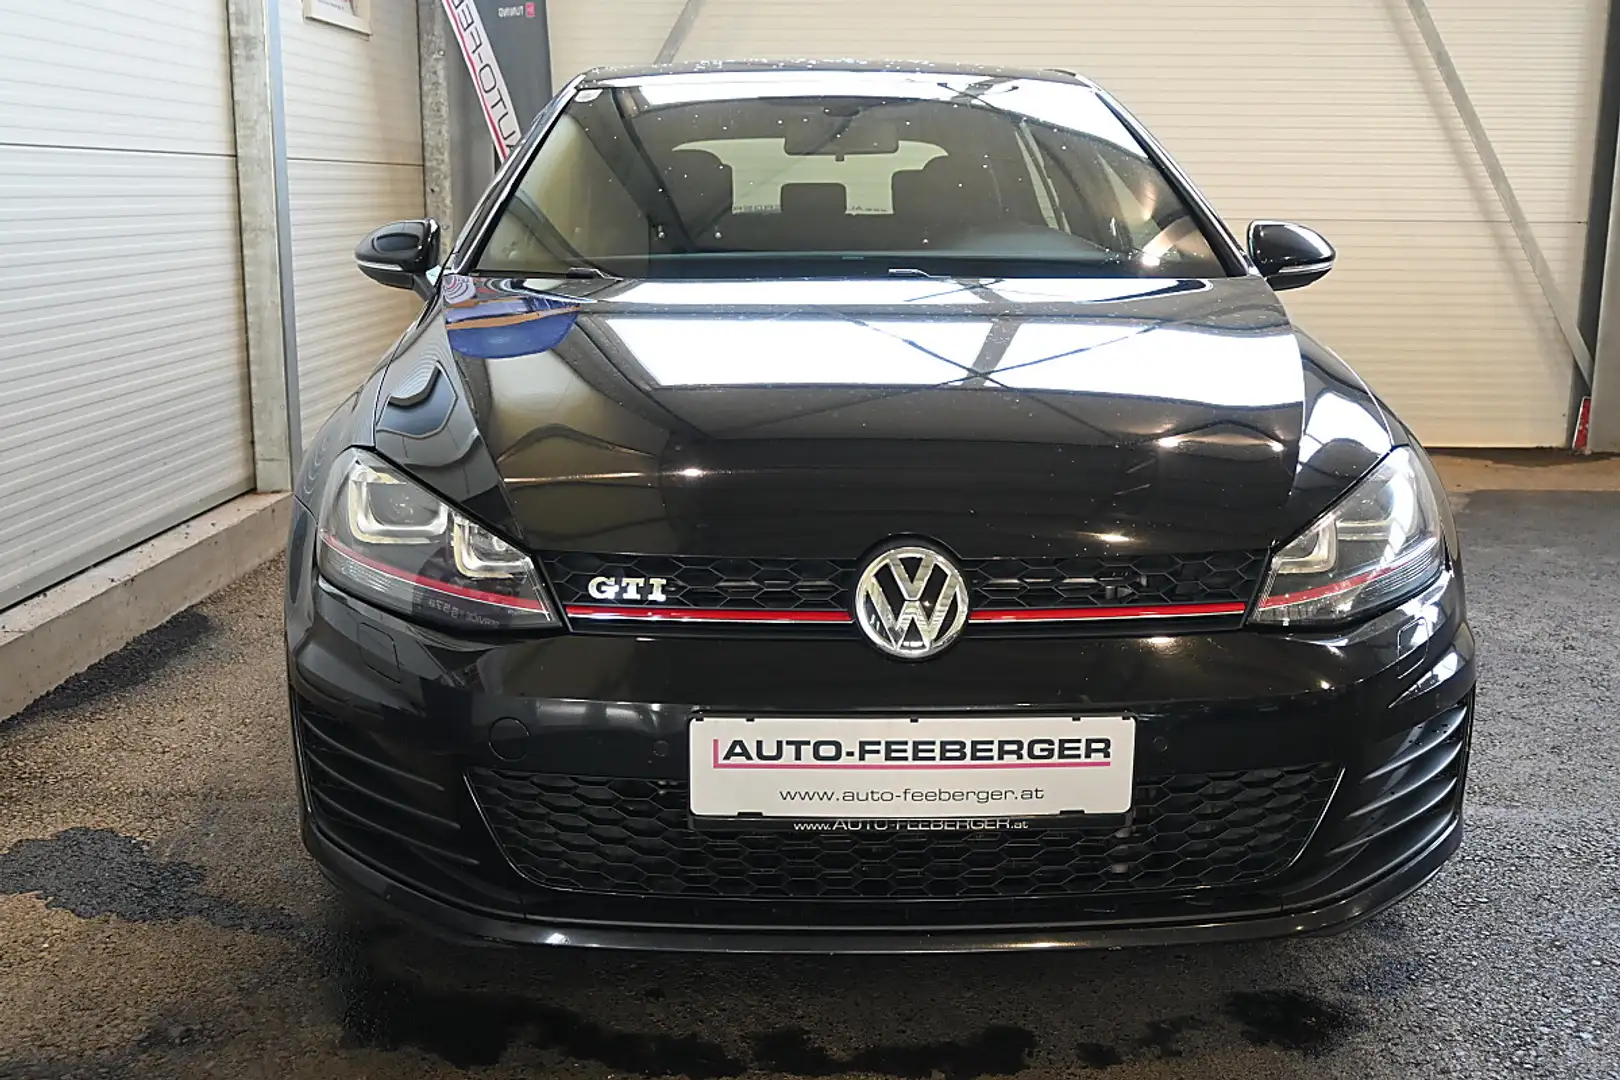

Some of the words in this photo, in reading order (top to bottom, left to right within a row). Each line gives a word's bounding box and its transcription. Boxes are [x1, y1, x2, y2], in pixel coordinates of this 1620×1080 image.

[588, 576, 667, 602] GTI
[858, 547, 967, 657] VW
[722, 738, 1111, 762] AUTO-FEEBERGER
[779, 786, 1044, 806] www.auto-feeberger.at
